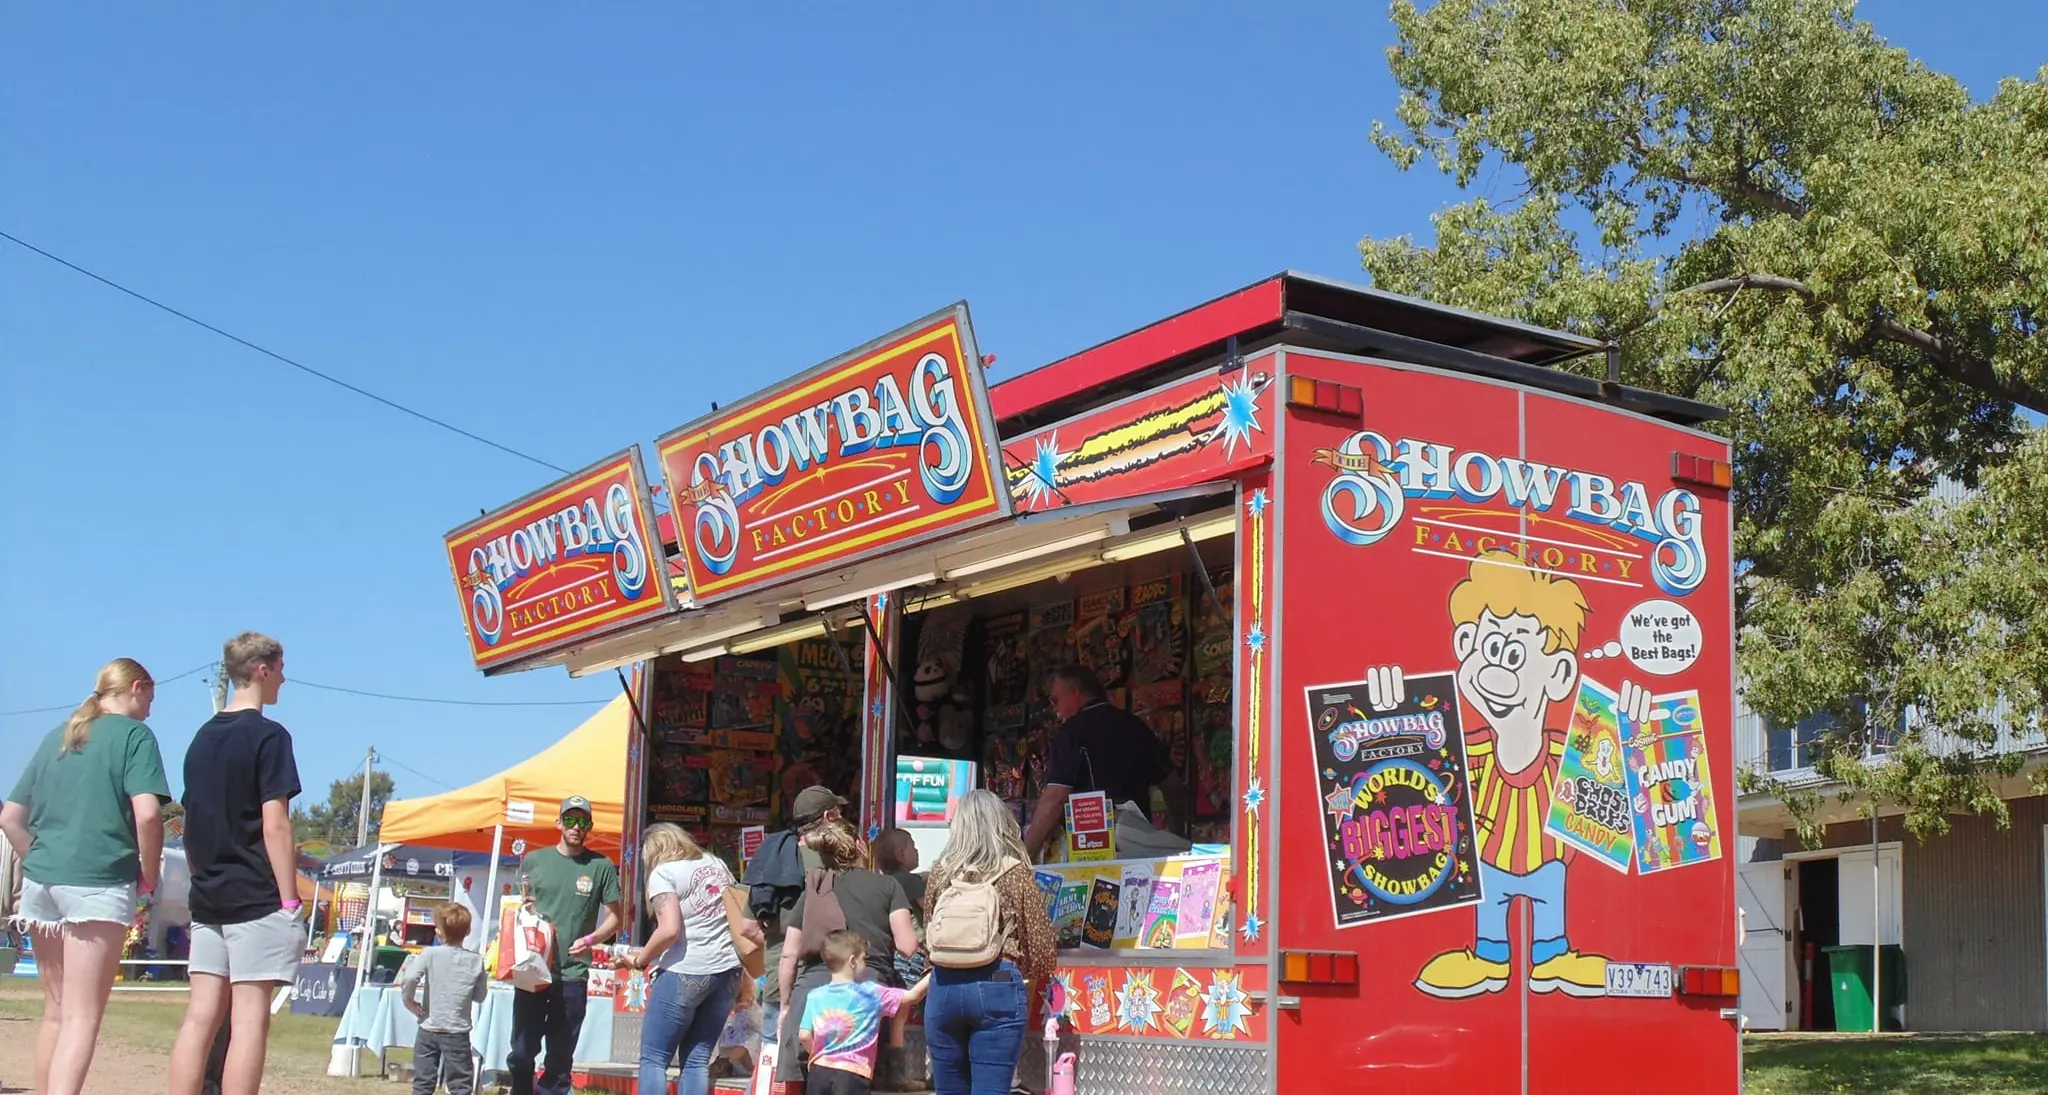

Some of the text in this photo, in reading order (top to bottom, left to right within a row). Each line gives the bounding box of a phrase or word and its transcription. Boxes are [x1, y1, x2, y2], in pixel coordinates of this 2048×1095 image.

[691, 352, 972, 574] SHOWBAG
[751, 479, 911, 551] FACTORY
[1321, 431, 1707, 596] SHOWBAG
[469, 483, 646, 645] SHOWBAG
[1414, 525, 1633, 579] FACTORY
[510, 578, 611, 629] FACTORY
[1631, 614, 1691, 631] We've got
[1632, 644, 1696, 661] Best Bags!
[1653, 629, 1673, 644] the
[1333, 710, 1447, 762] SHOWBAG
[922, 774, 946, 787] FUN
[1638, 757, 1697, 788] CANDY
[1342, 804, 1459, 860] BIGGEST
[1565, 814, 1617, 852] CANDY
[1574, 793, 1631, 834] DROPS
[1651, 797, 1698, 827] GUM
[1363, 851, 1448, 896] SHOWBAG
[1608, 968, 1669, 990] V39 743
